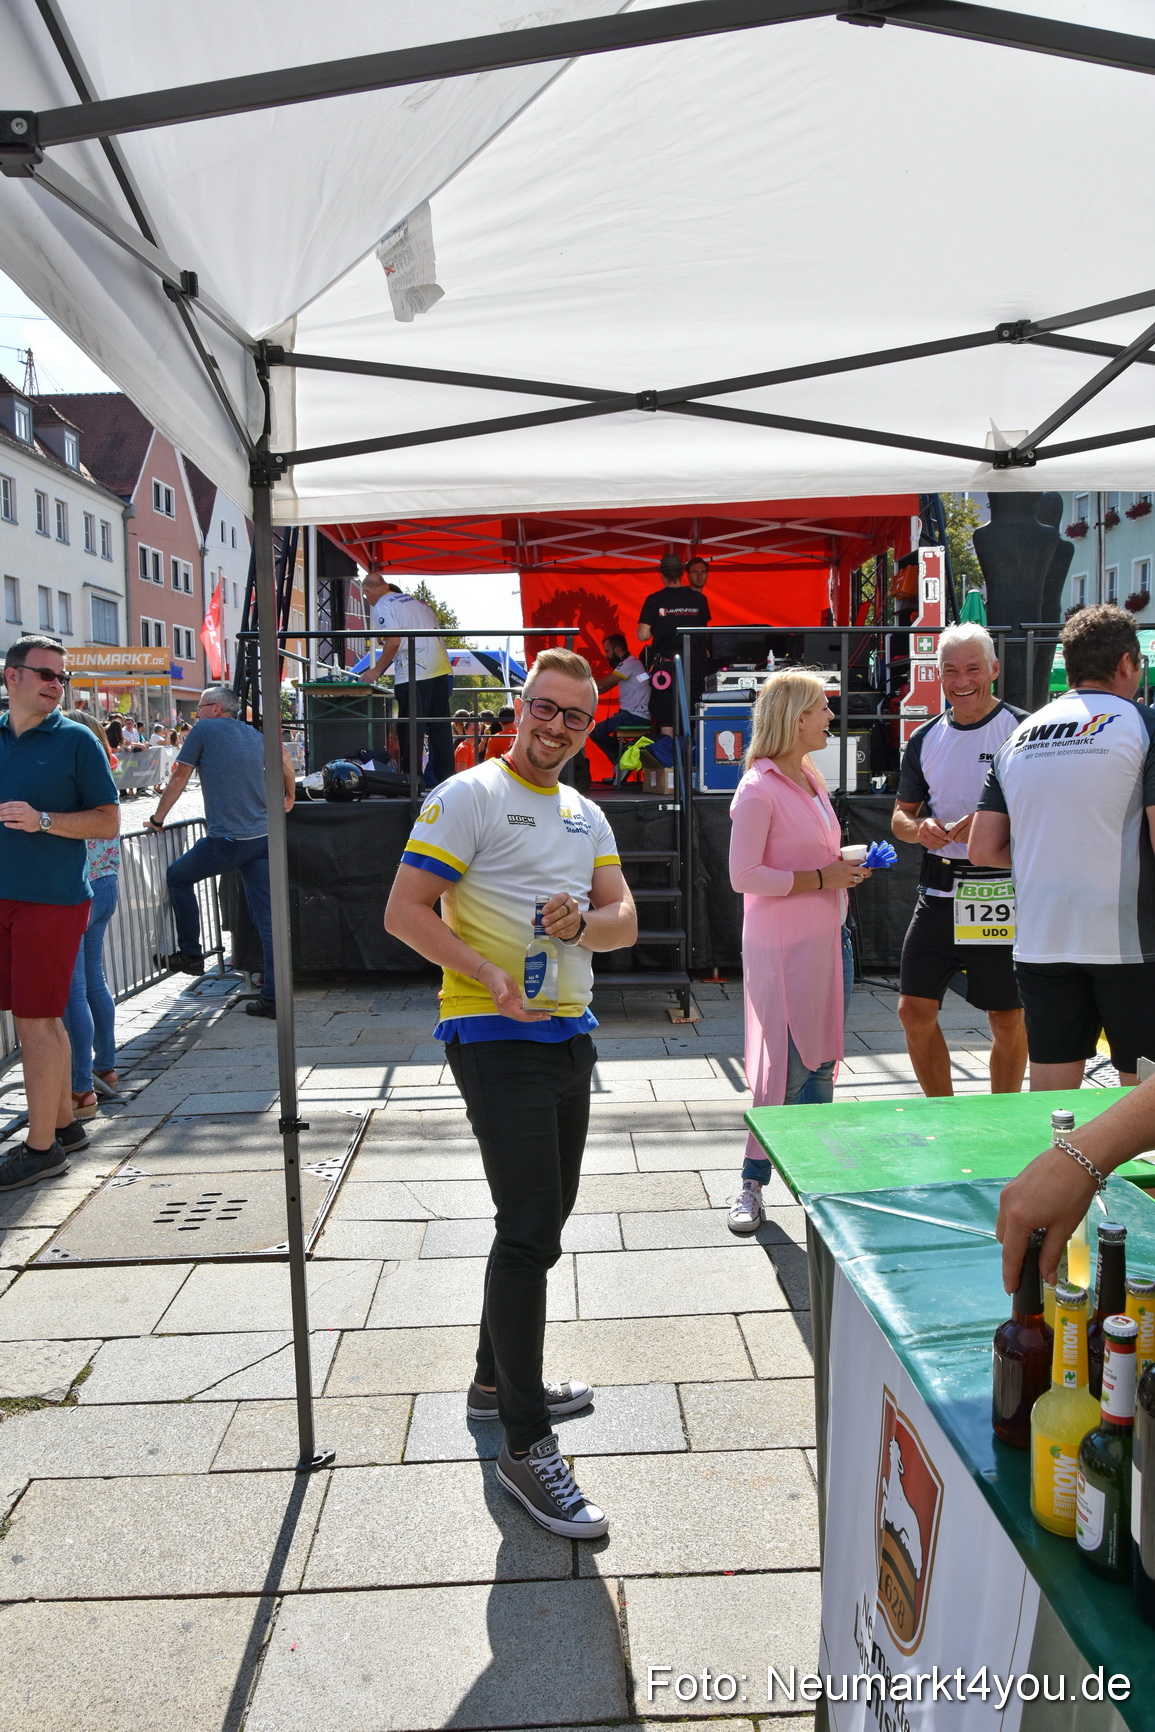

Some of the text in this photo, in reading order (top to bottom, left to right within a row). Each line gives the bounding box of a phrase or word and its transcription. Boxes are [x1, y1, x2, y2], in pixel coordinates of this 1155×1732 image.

[1015, 721, 1079, 748] swn
[1012, 737, 1095, 757] stadtwerke neumarkt
[1034, 751, 1056, 759] bieten
[979, 753, 995, 761] sw
[508, 815, 535, 825] BOCK
[964, 904, 1015, 922] 129
[982, 928, 1008, 937] UDO
[1062, 1322, 1079, 1354] now
[1053, 1453, 1077, 1502] now
[878, 1566, 906, 1630] 1628
